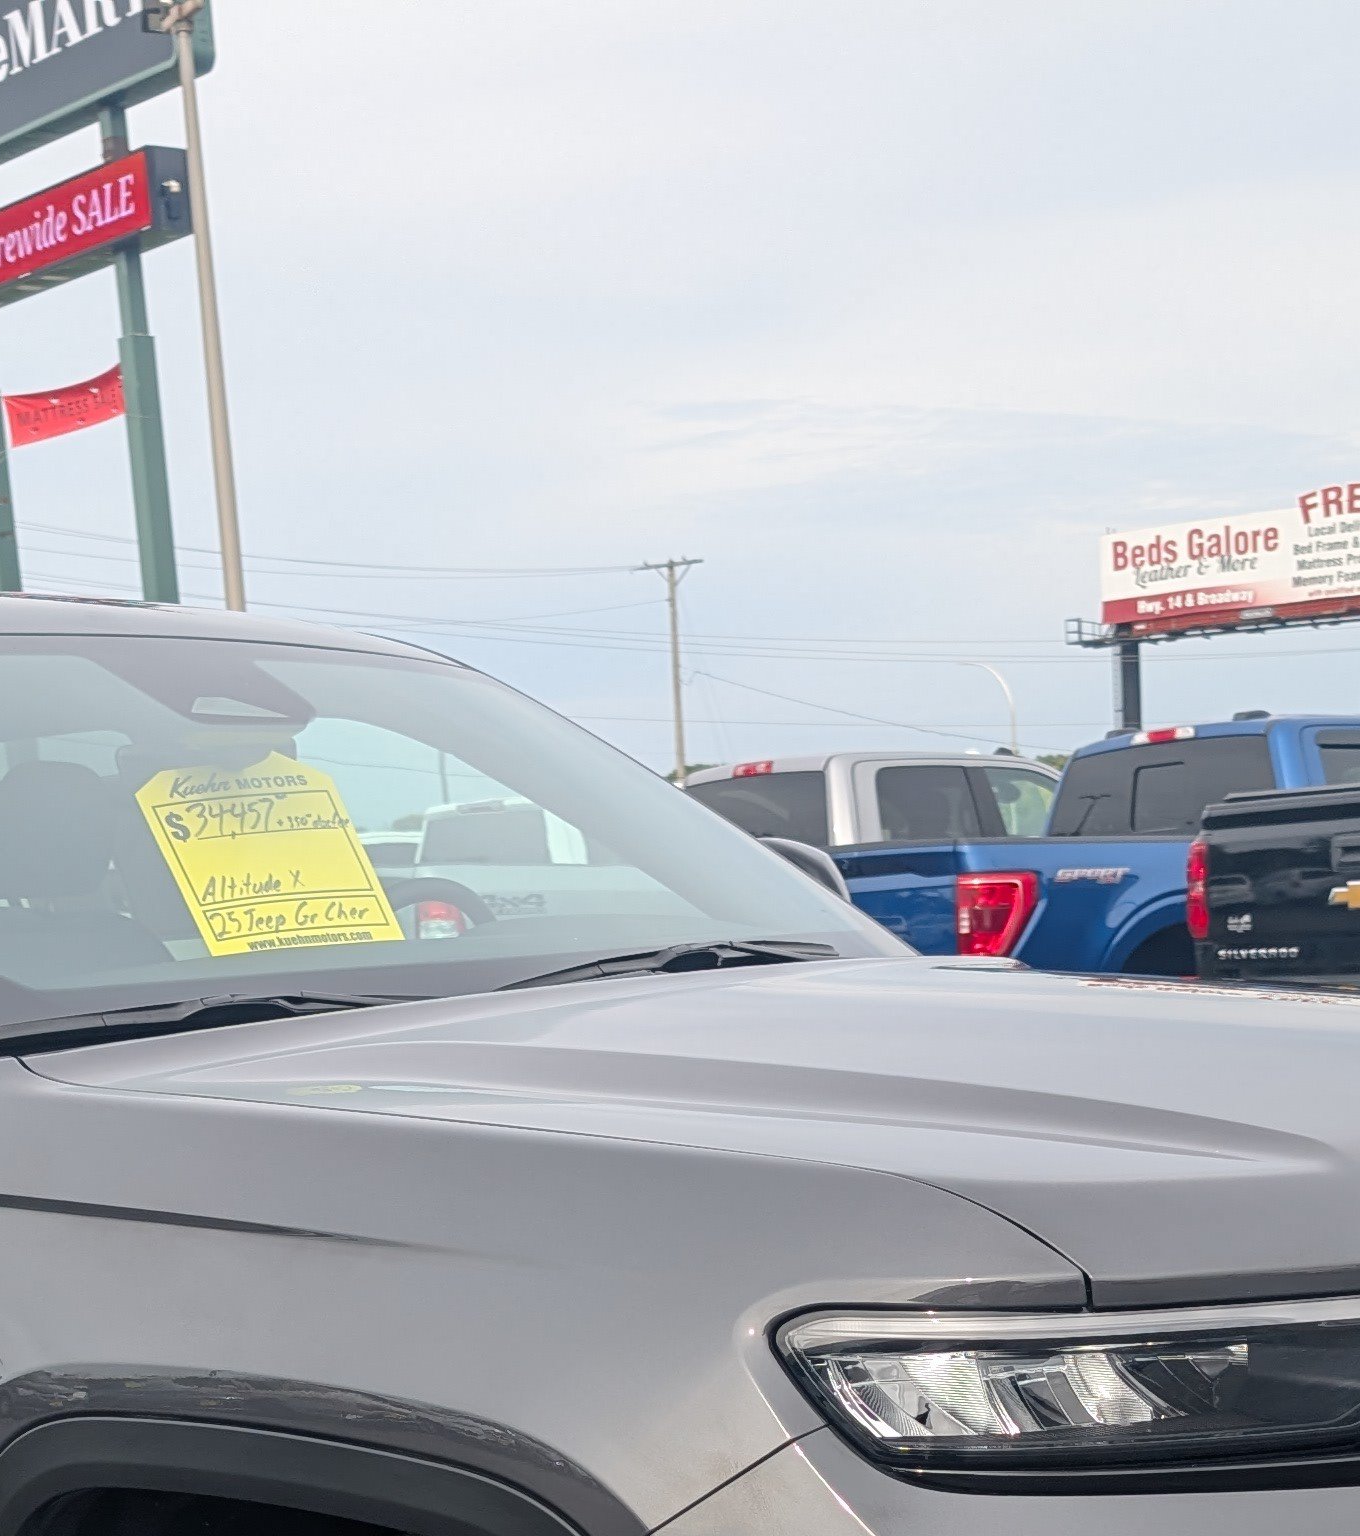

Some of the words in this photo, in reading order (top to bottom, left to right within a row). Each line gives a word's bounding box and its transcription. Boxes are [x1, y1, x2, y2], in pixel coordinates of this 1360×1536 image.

[71, 174, 136, 237] SALE
[1308, 523, 1336, 537] Local
[1112, 535, 1178, 571] Beds
[1187, 525, 1279, 560] Galore
[1293, 543, 1313, 555] Bed
[1316, 540, 1348, 552] Frame
[1133, 564, 1191, 588] Leather
[1197, 557, 1210, 576] &
[1217, 553, 1258, 573] More
[1297, 557, 1343, 571] Mattress
[1292, 575, 1334, 588] Memory
[1167, 594, 1182, 609] 14
[1196, 589, 1254, 607] Broadway
[169, 773, 232, 799] Kuehn
[235, 774, 308, 790] MOTORS
[202, 873, 282, 902] Altitude
[288, 869, 306, 887] X
[1054, 867, 1131, 884] SPORT
[209, 911, 242, 939] 25
[294, 901, 319, 926] Gr
[324, 901, 370, 922] Cher
[247, 931, 374, 951] www.kuehnmotors.com
[1217, 946, 1299, 960] SILVERADO
